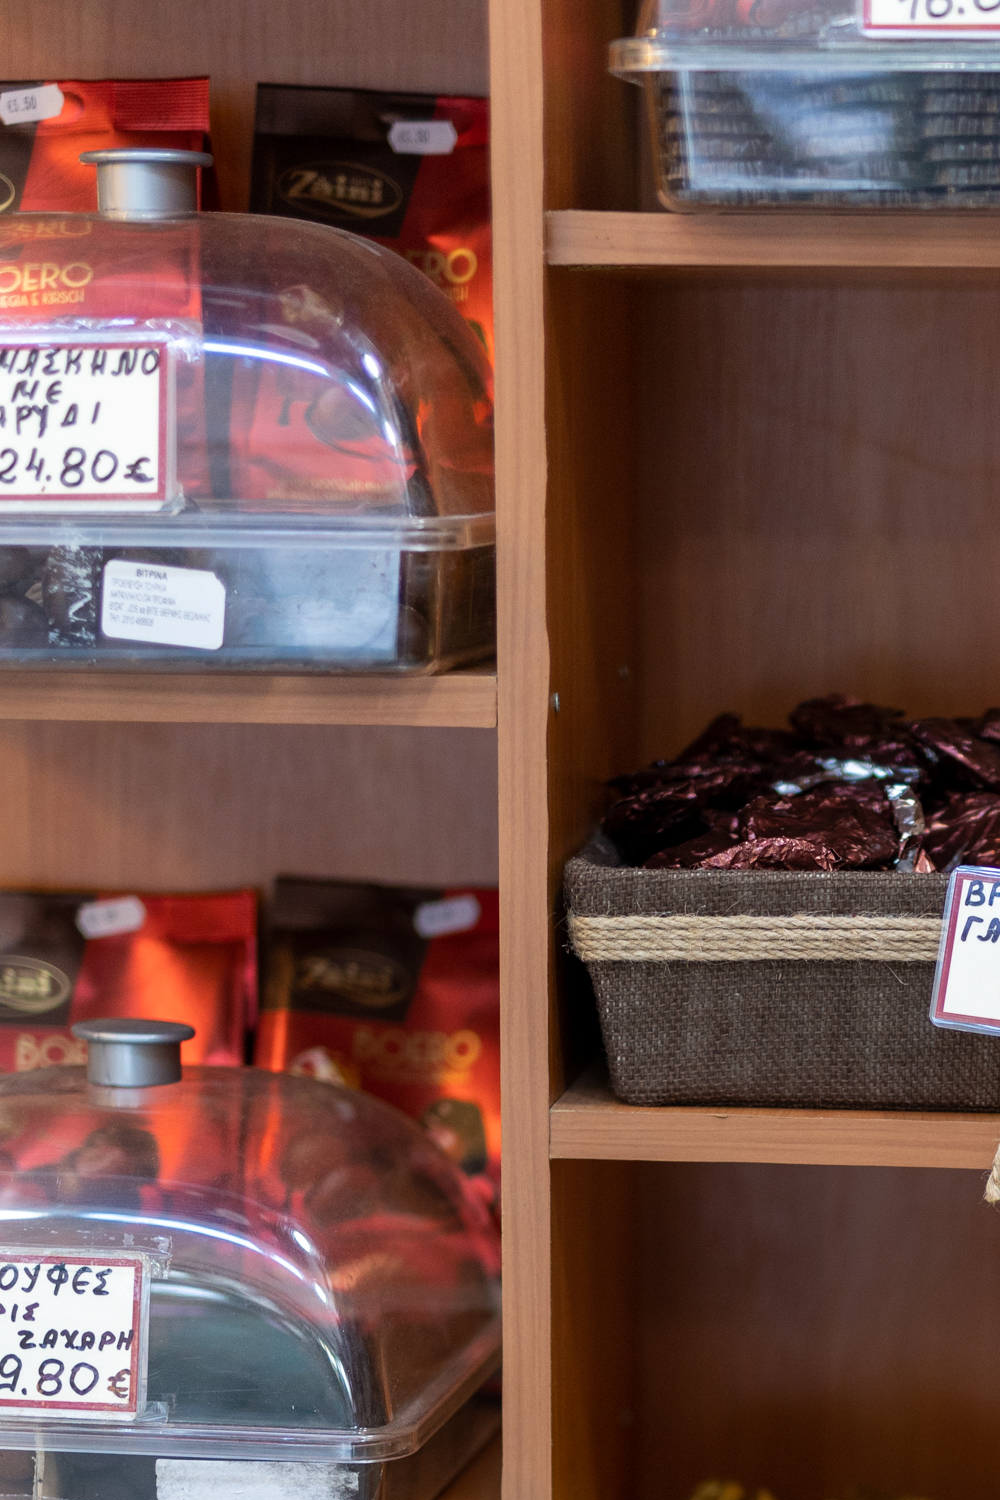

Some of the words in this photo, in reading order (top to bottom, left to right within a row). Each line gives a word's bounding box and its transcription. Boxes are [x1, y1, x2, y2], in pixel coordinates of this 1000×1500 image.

[0, 262, 94, 294] OERO
[0, 293, 29, 308] EGIA
[0, 348, 160, 377] ΜΑΣΚΗΝΟ
[0, 401, 102, 438] ΡΥΔΙ
[0, 1261, 113, 1296] ΟΥΦΕΣ
[17, 1328, 134, 1351] ΖΑΧΑΡΗ
[0, 1353, 132, 1398] 9.80€
